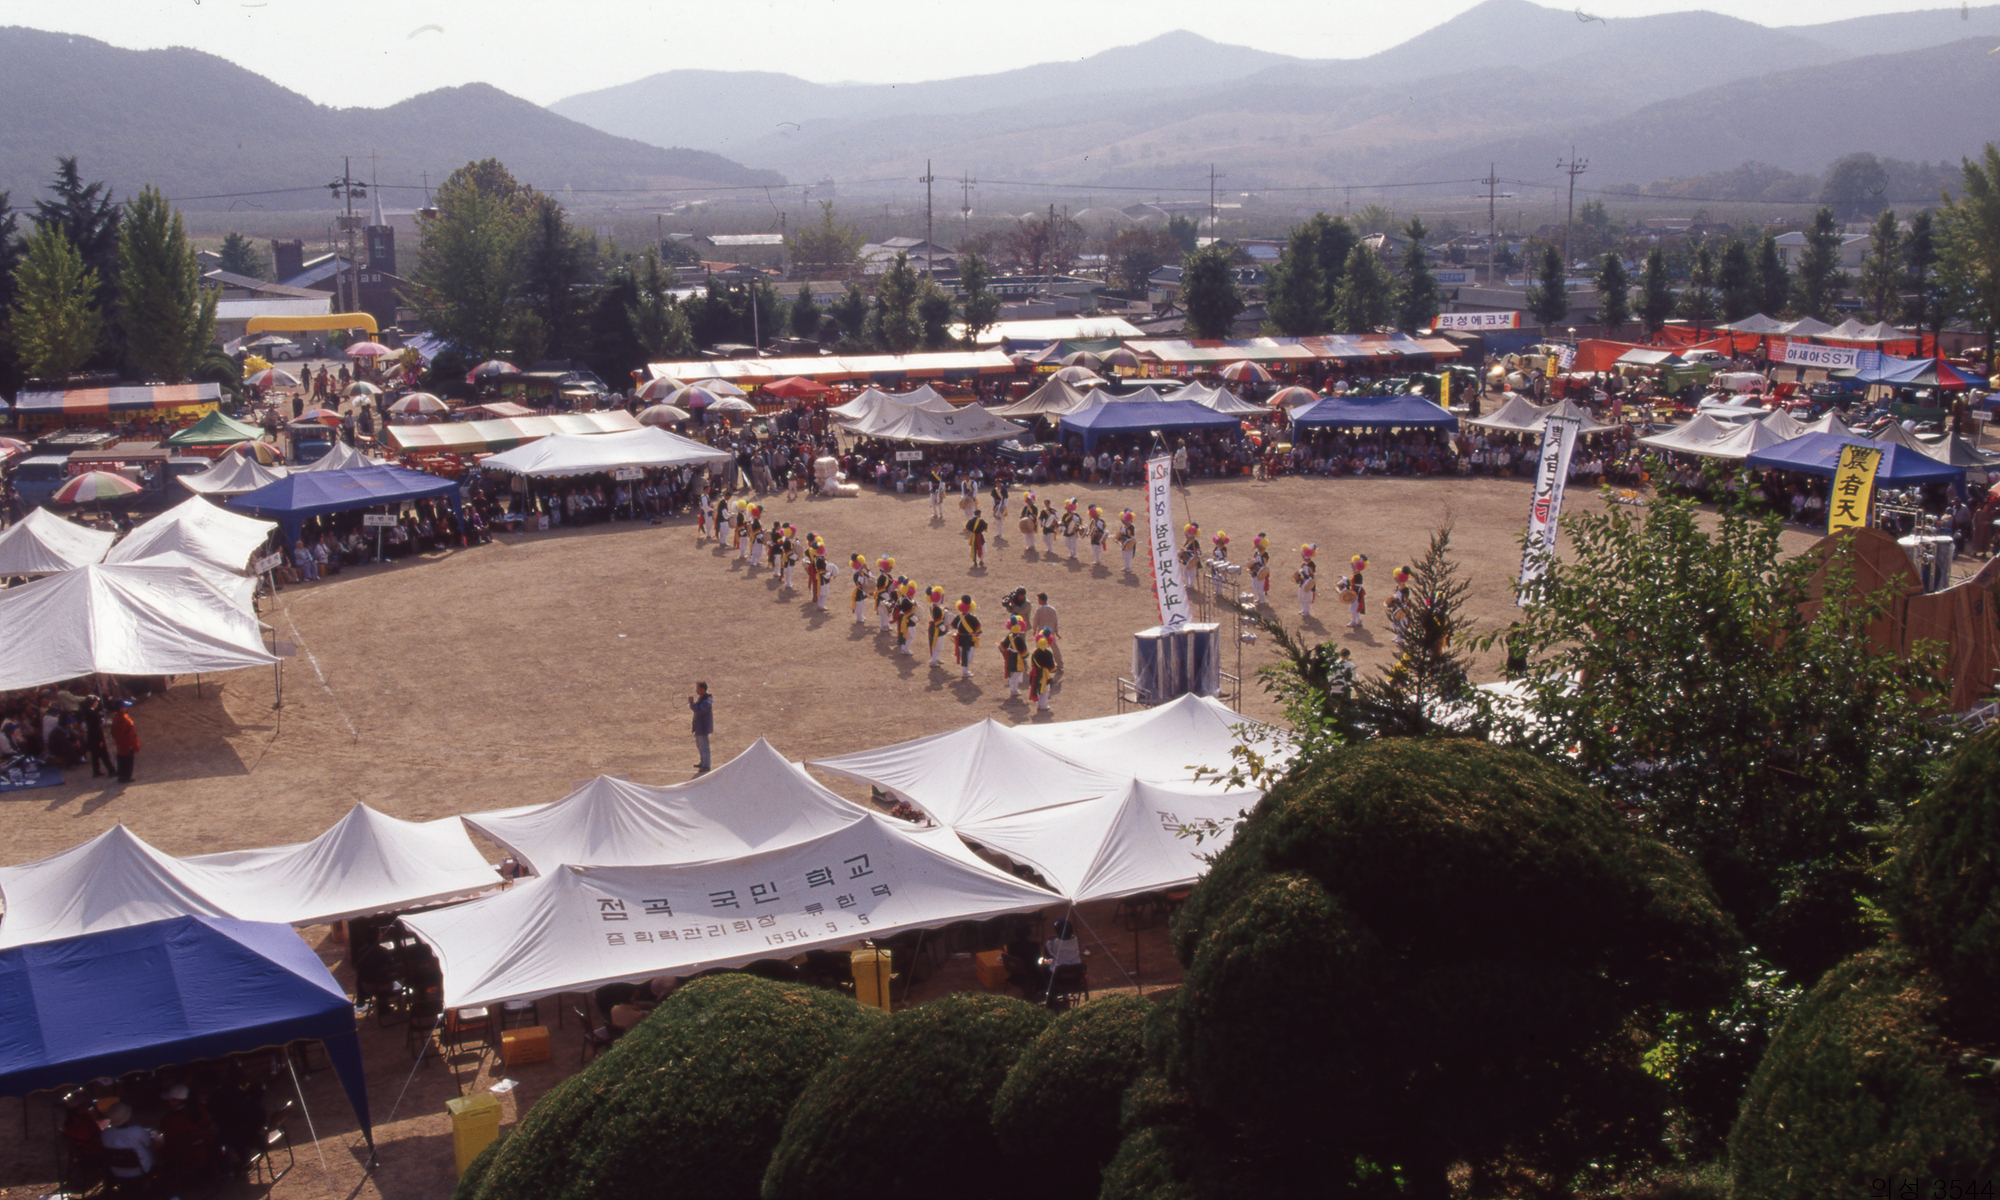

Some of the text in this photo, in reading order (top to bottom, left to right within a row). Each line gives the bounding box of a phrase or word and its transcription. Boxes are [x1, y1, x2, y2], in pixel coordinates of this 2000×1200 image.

[1441, 314, 1511, 327] 한성에코넷
[1787, 349, 1854, 365] 아세아SS기
[1832, 450, 1870, 531] 農者天
[597, 898, 673, 921] 점곡
